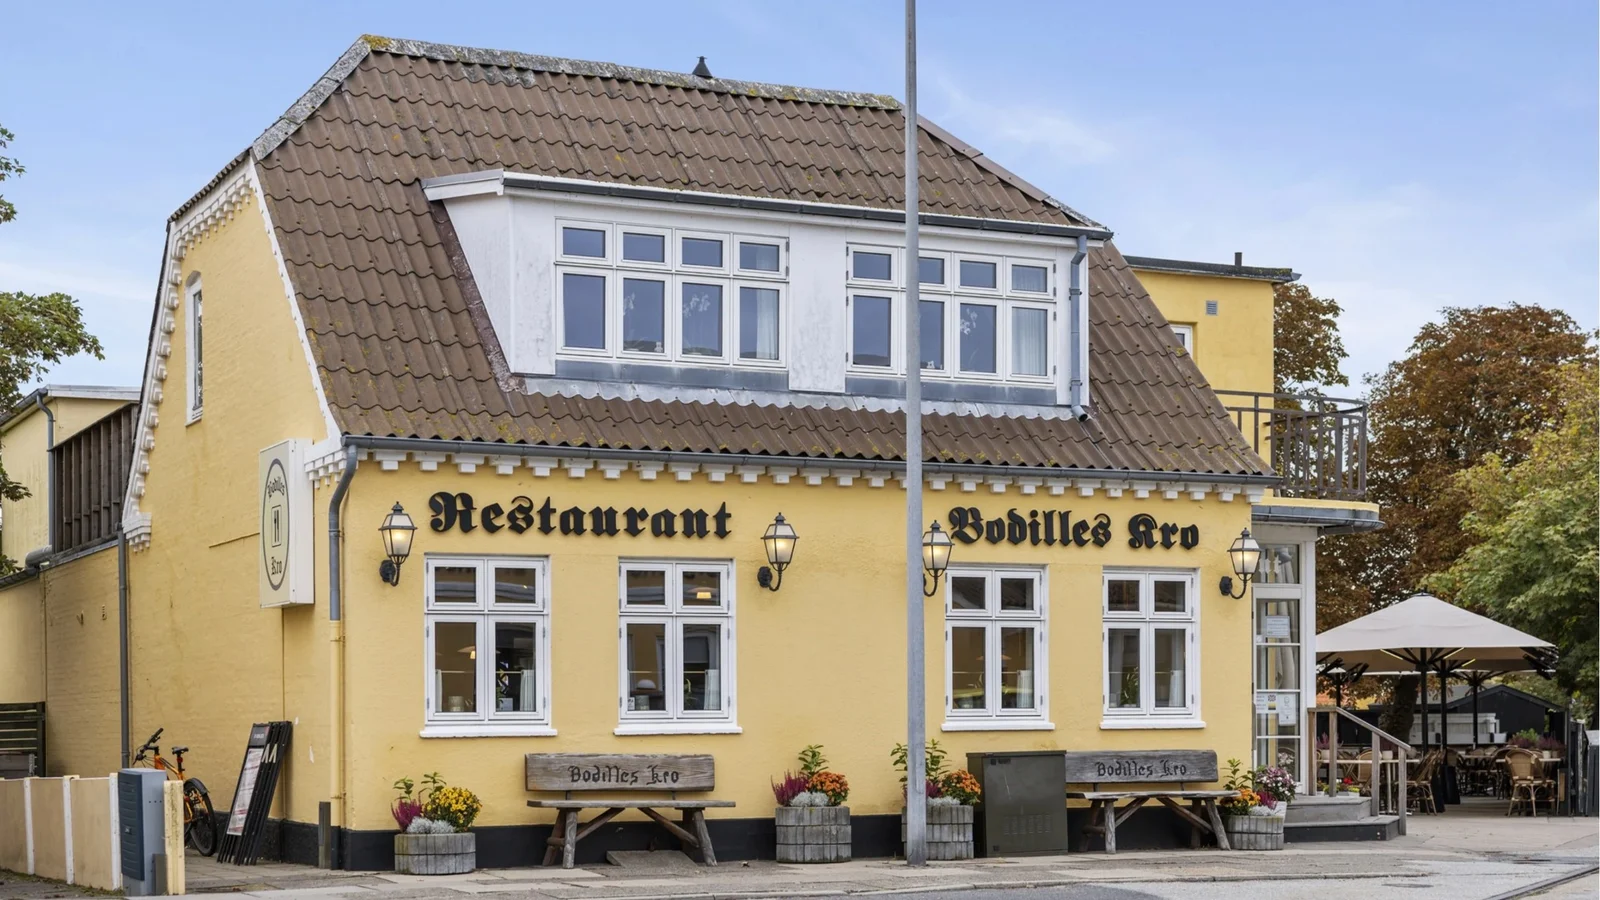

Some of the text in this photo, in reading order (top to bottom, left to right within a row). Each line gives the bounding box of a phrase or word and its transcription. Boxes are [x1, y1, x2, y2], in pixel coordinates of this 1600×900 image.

[428, 491, 732, 539] Restaurant
[948, 506, 1199, 550] Bodilles Kro
[271, 556, 282, 575] Kro
[567, 765, 639, 786] Bodilles
[1094, 760, 1153, 778] Bodilles
